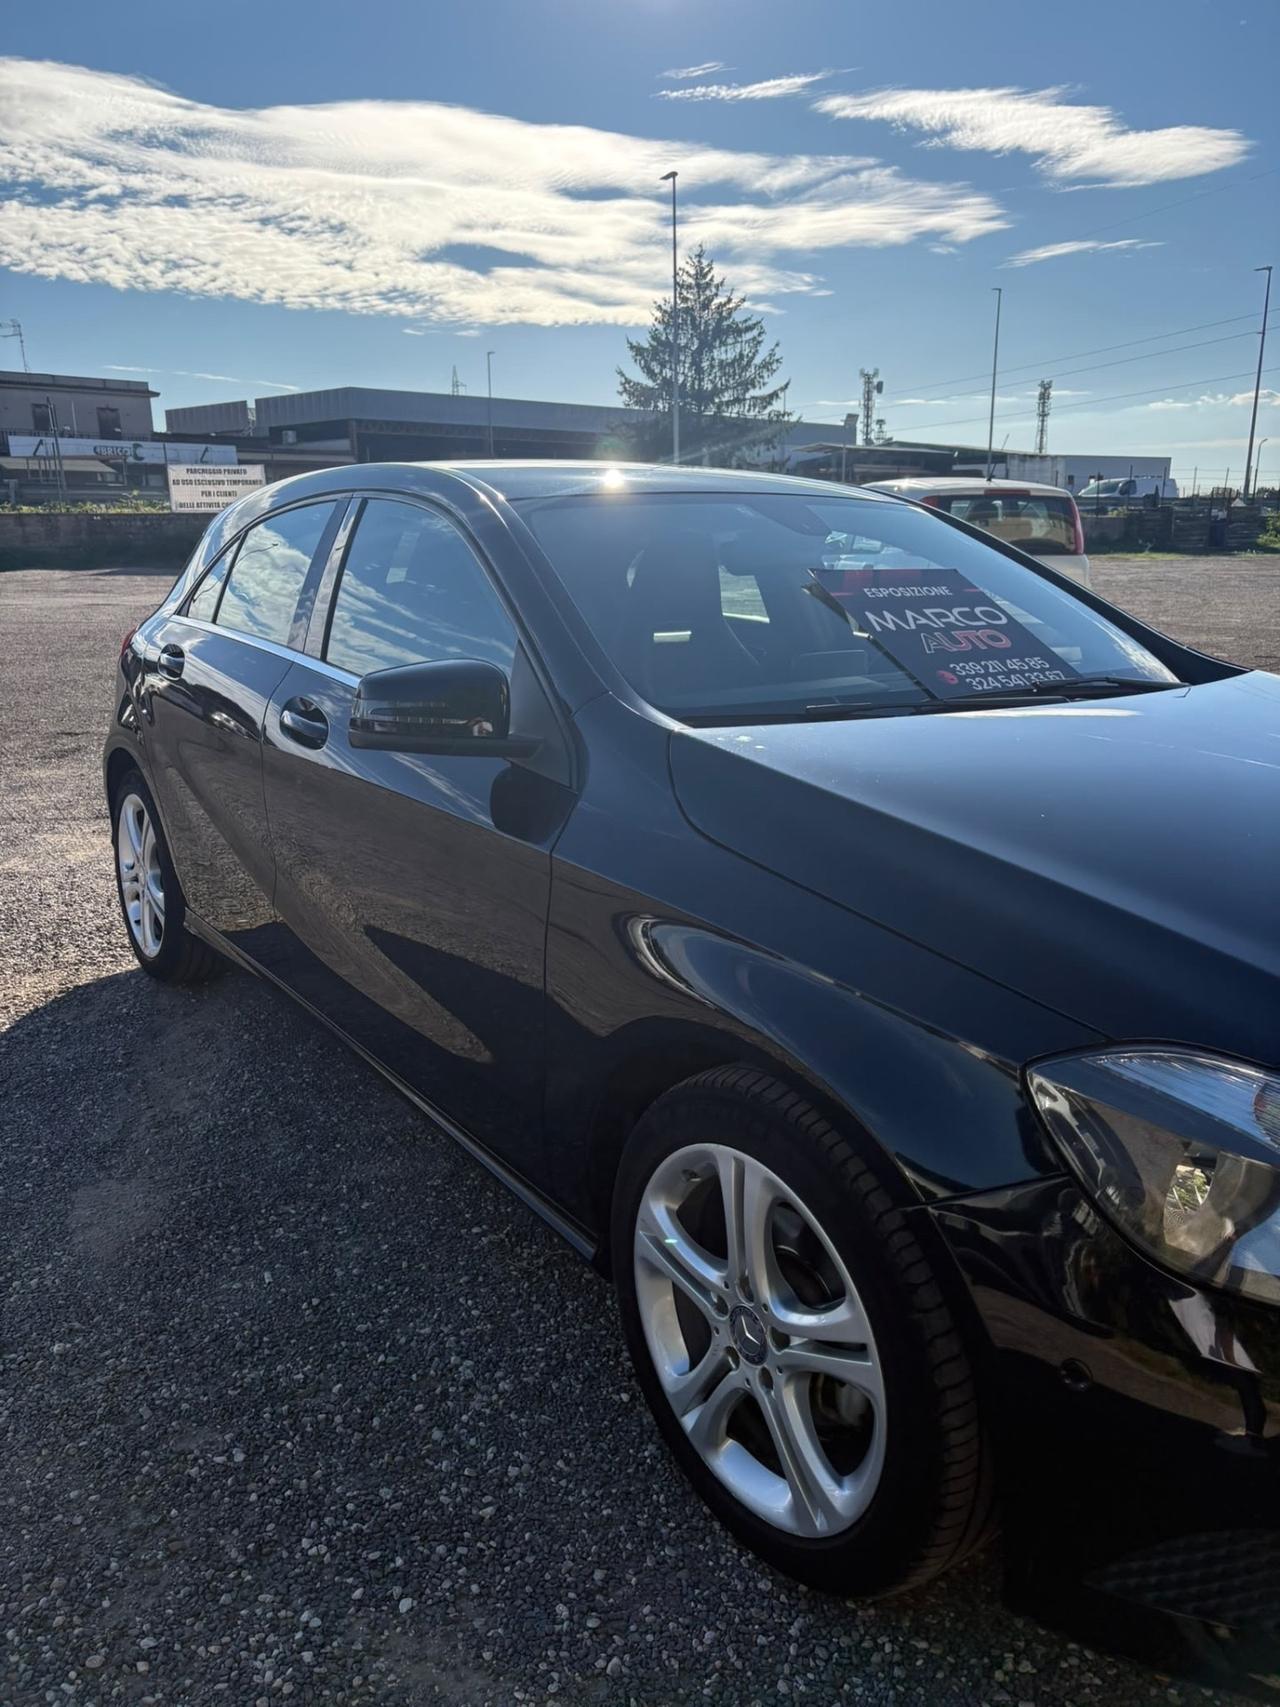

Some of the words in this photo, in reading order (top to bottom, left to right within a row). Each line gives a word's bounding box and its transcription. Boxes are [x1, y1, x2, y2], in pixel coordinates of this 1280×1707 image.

[863, 586, 952, 598] ESPOSIZIONE
[864, 606, 1008, 632] MARCO
[920, 629, 1012, 654] AUTO
[949, 661, 985, 676] 339
[981, 660, 1008, 673] 211
[1006, 658, 1029, 671] 45
[1025, 656, 1050, 669] 85
[965, 676, 1002, 691] 324
[997, 673, 1030, 687] 541
